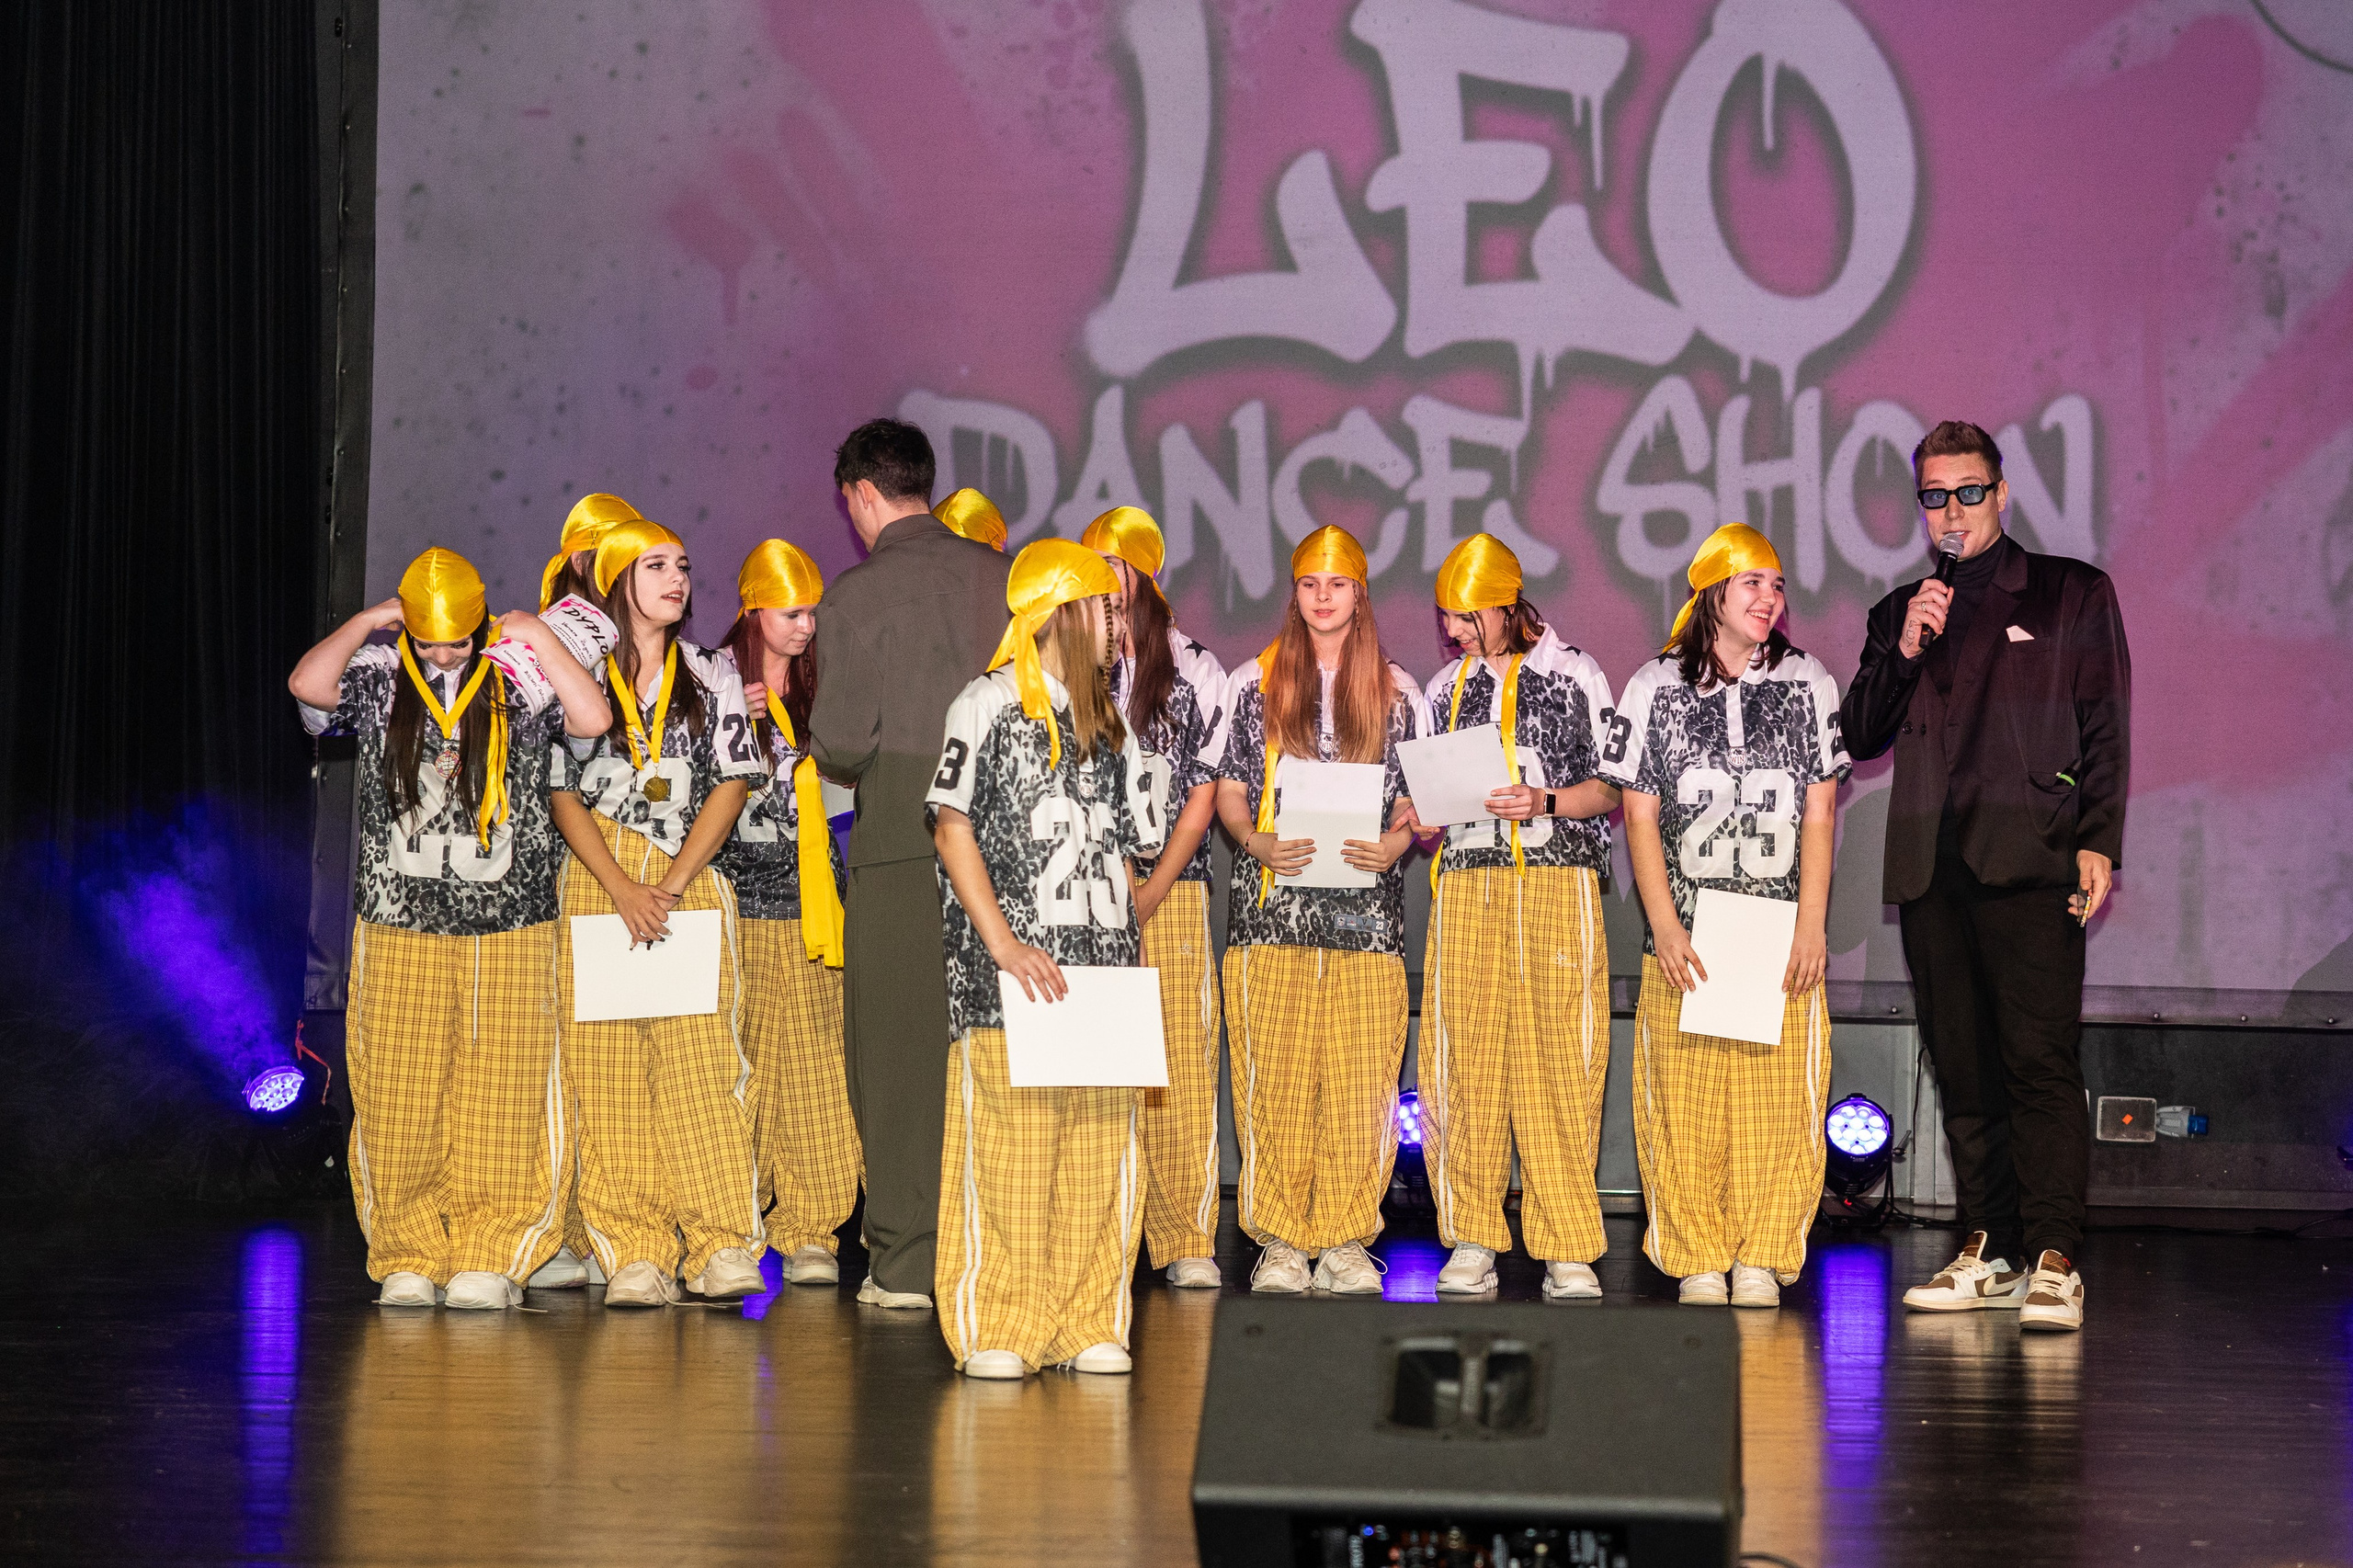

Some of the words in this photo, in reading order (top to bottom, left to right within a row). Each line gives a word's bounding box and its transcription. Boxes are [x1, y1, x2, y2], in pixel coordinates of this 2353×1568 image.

[1086, 0, 1918, 379] LEO
[897, 385, 1559, 599] DANCE
[1730, 756, 1745, 765] WIN
[1030, 797, 1129, 930] 23
[1677, 769, 1795, 879] 23
[1375, 920, 1384, 930] 23
